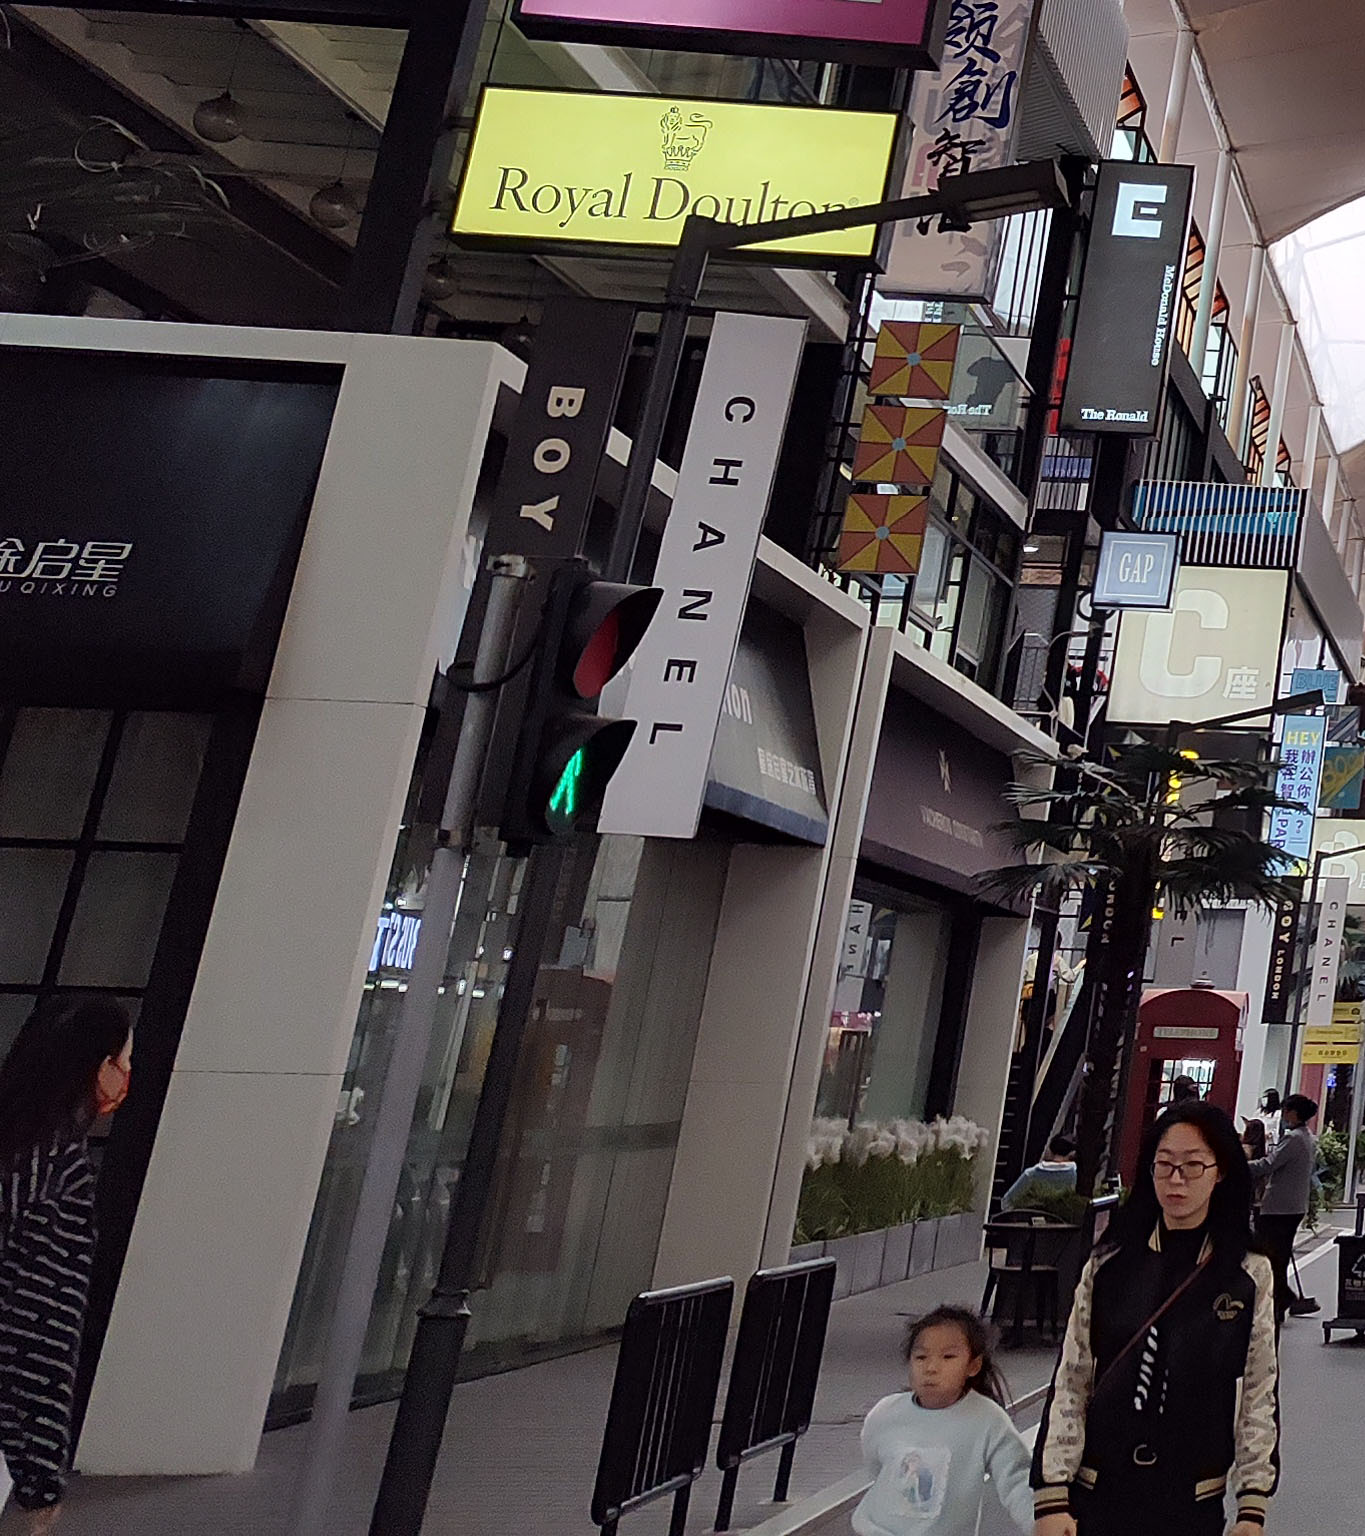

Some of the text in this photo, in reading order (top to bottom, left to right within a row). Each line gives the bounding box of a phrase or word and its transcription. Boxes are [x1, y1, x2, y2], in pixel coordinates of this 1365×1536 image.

[489, 166, 630, 228] Royal
[1150, 264, 1176, 367] McDonald House
[1080, 407, 1150, 423] The Ronald
[519, 385, 586, 532] BOY
[648, 396, 757, 746] CHANEL
[1119, 552, 1155, 584] GAP
[1285, 730, 1321, 745] HEY
[1271, 949, 1286, 1000] LONDON
[1316, 900, 1339, 1003] CHANEL
